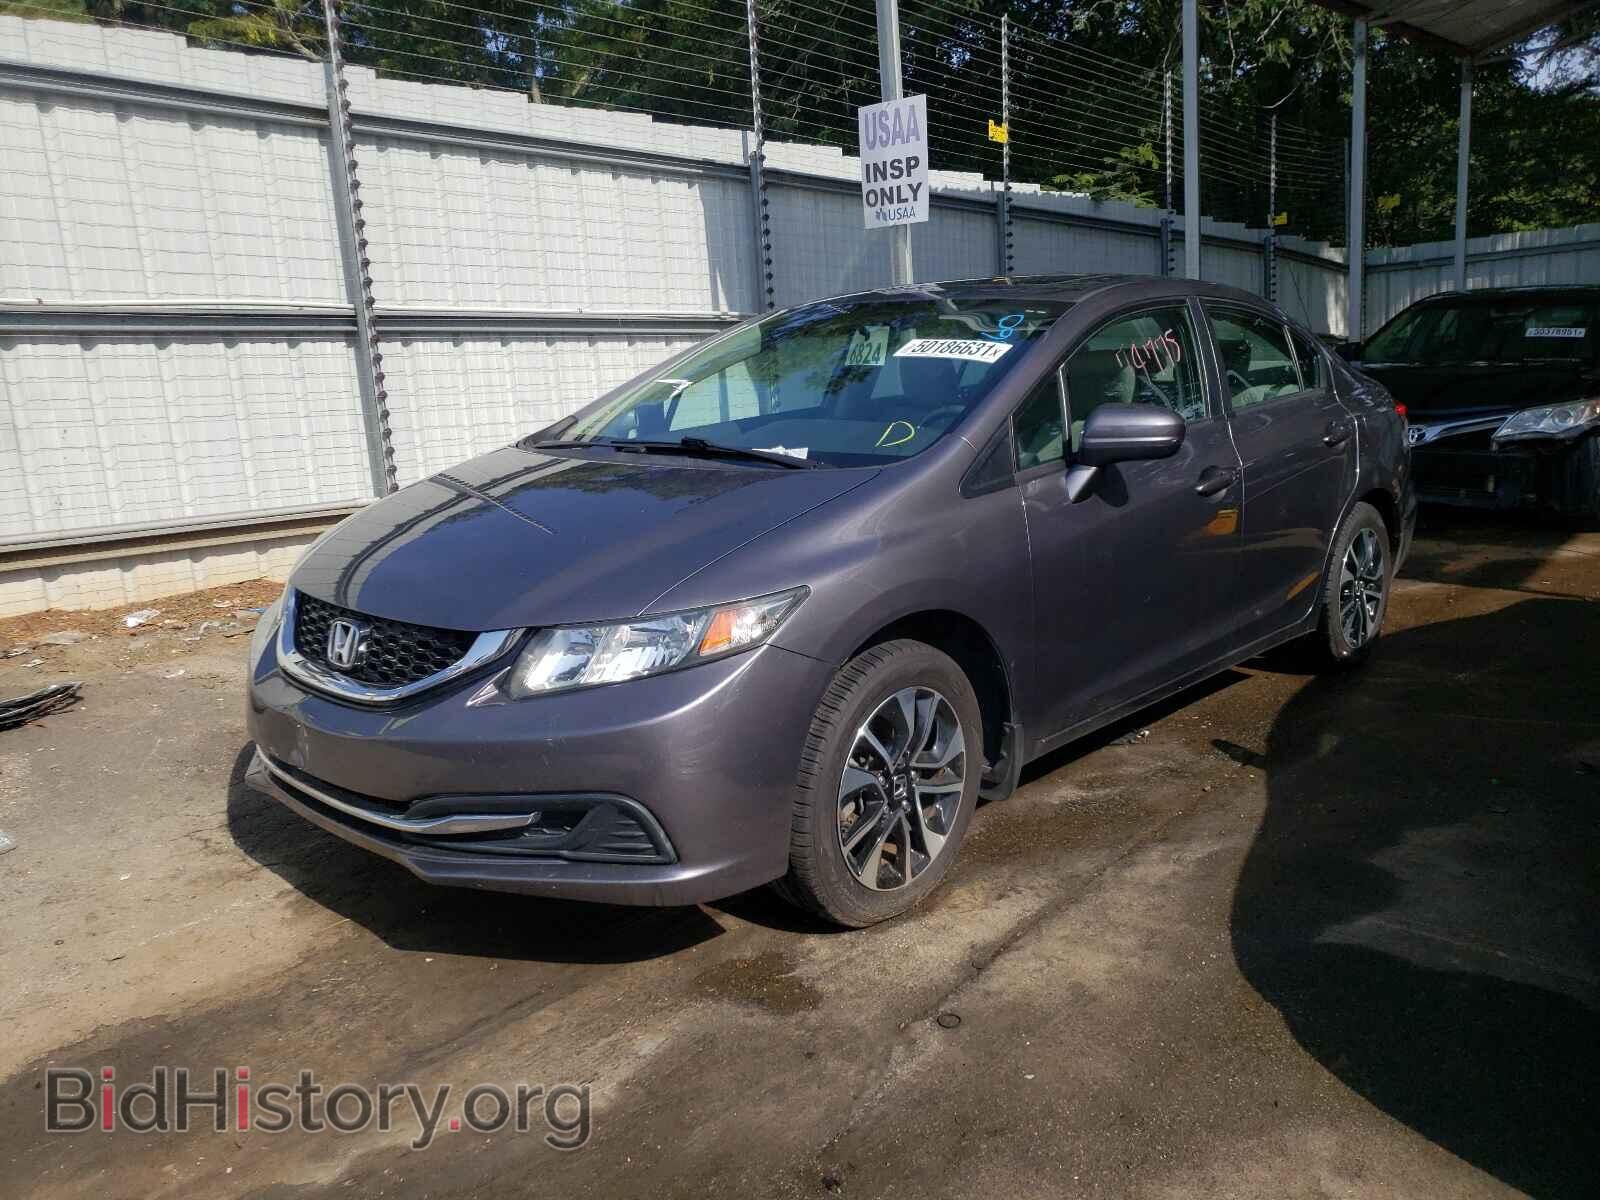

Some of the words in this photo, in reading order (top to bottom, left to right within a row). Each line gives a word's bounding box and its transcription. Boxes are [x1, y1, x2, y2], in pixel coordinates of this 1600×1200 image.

[864, 104, 920, 151] USAA
[865, 155, 920, 183] INSP
[865, 182, 922, 208] ONLY
[888, 206, 916, 220] USAA
